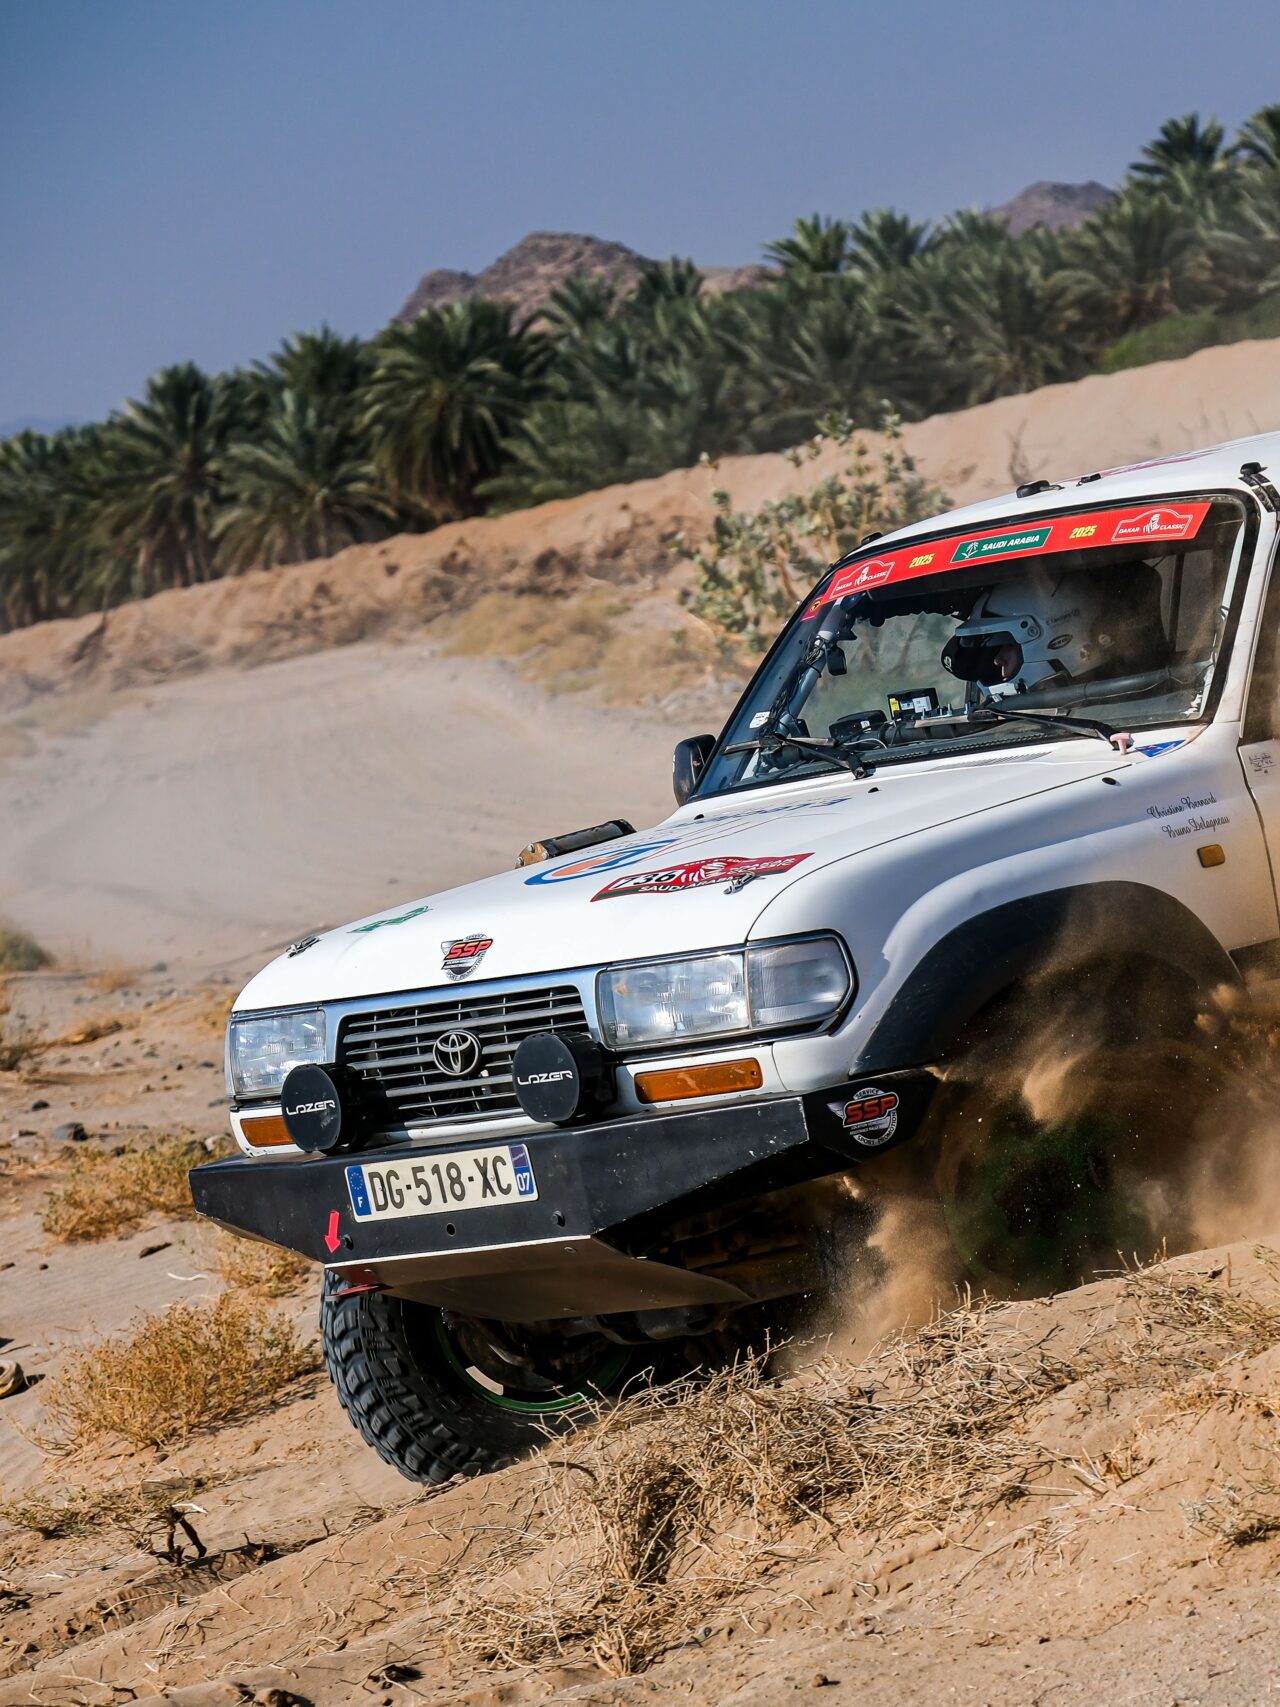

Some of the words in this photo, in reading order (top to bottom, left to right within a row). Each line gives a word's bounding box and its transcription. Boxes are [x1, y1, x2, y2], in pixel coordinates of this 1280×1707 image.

[1069, 525, 1098, 539] 2025
[1118, 526, 1140, 534] DAKAR
[981, 540, 1007, 551] SAUDI
[1006, 534, 1040, 547] ARABIA
[908, 553, 935, 568] 2025
[446, 940, 492, 959] SSP
[846, 1095, 897, 1124] SSP
[368, 1155, 512, 1212] DG-518-XC
[516, 1172, 530, 1192] 07
[357, 1196, 363, 1208] F
